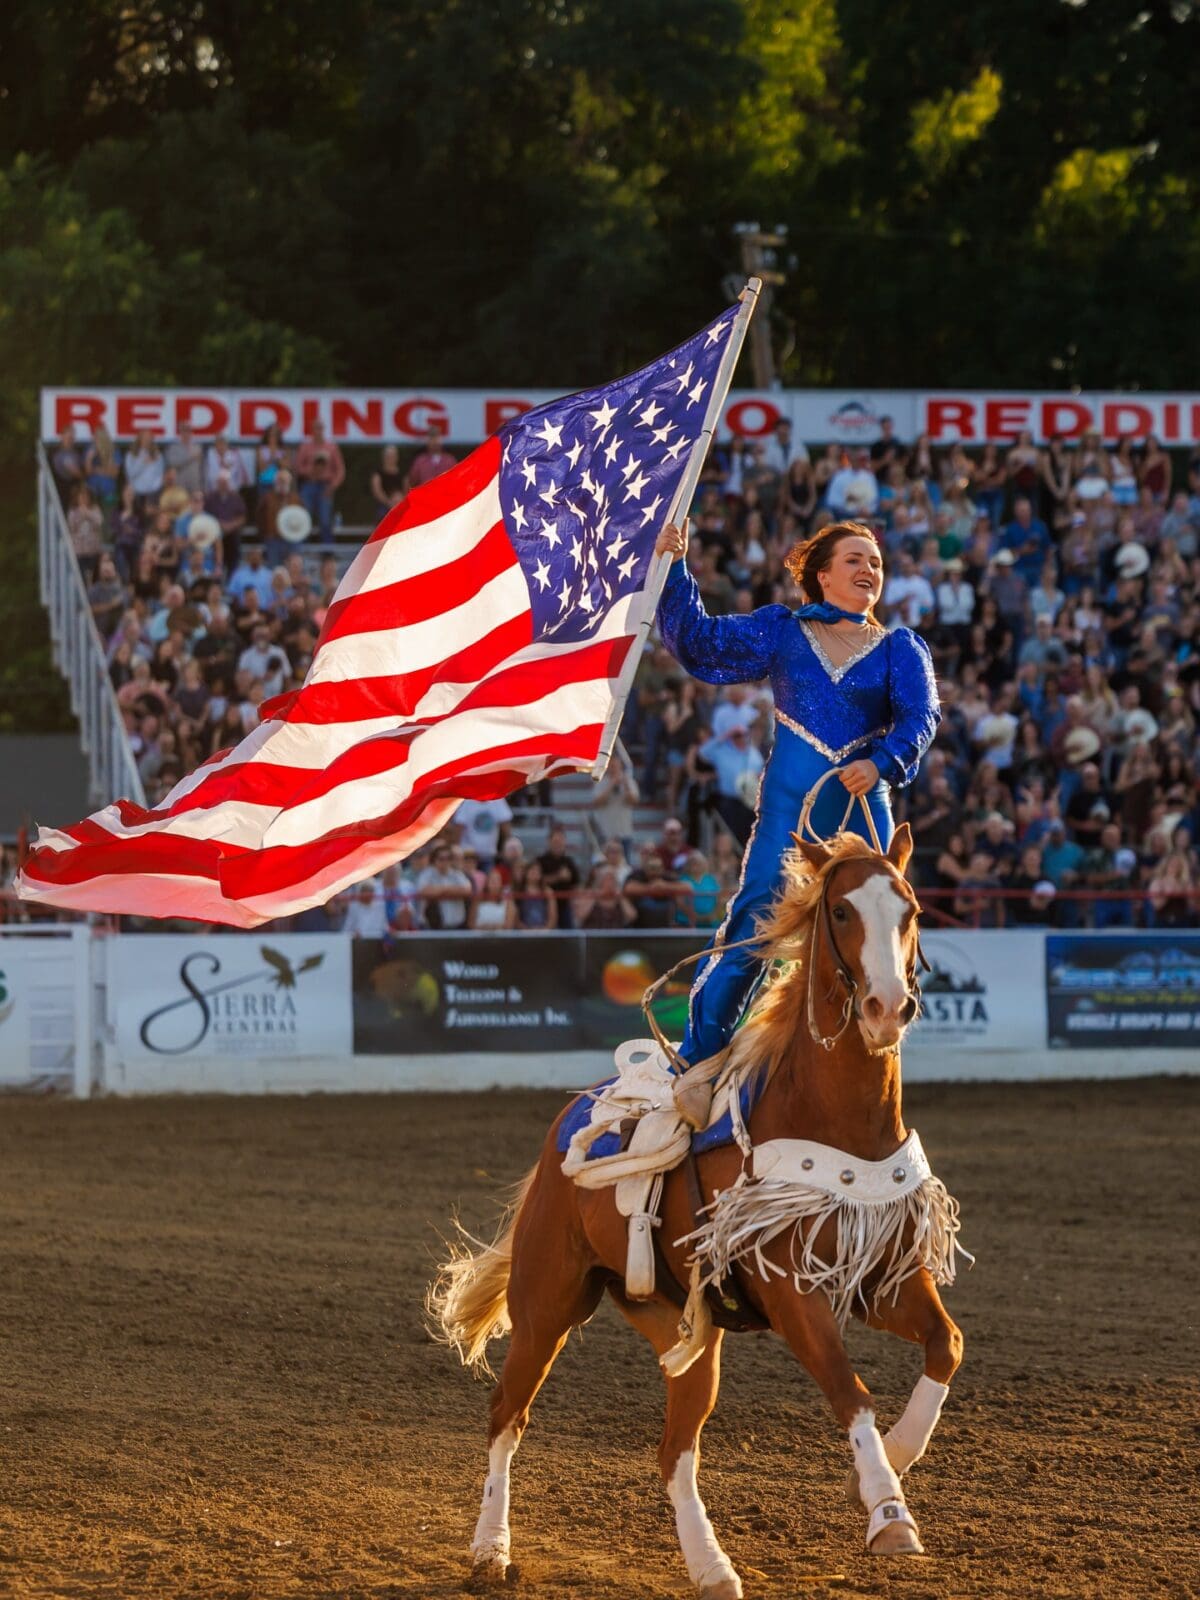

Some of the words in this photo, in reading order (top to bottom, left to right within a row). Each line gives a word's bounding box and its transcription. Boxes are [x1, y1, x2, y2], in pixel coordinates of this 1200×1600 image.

[54, 395, 449, 437] REDDING
[926, 400, 1200, 440] REDDI
[920, 999, 988, 1022] ASTA
